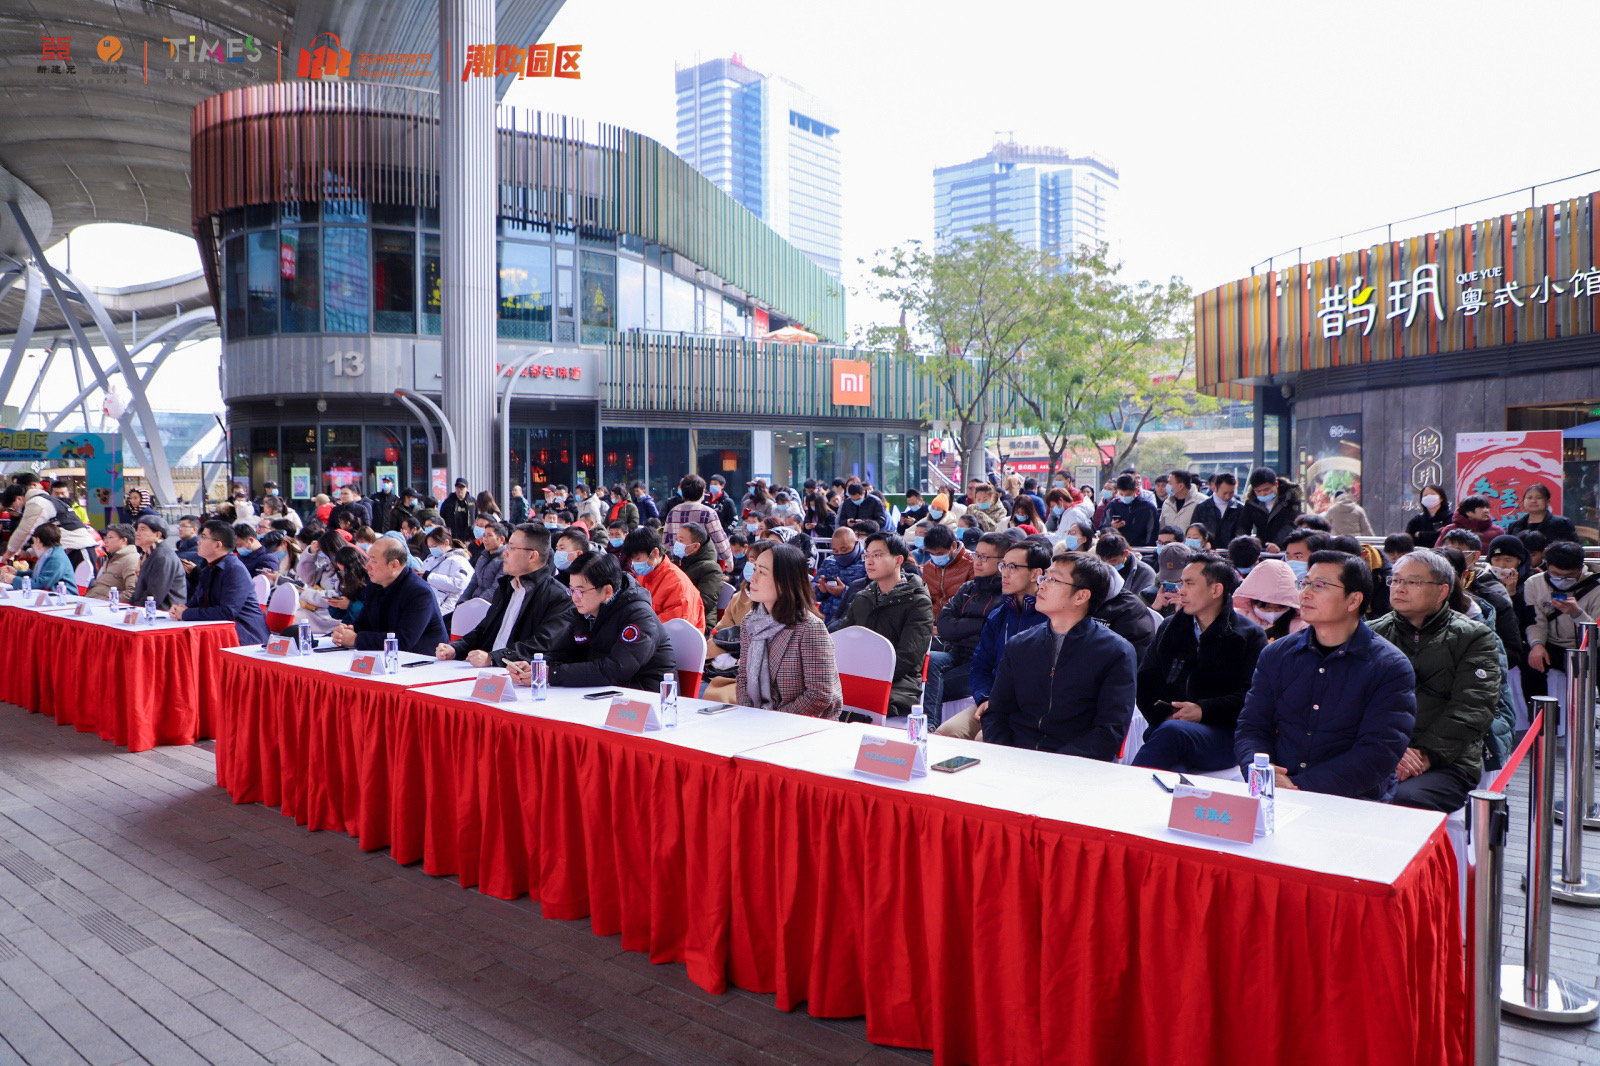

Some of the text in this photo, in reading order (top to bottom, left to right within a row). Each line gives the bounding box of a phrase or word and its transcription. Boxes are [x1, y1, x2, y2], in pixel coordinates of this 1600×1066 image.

[1455, 266, 1503, 285] QUE YUE
[1455, 266, 1600, 316] 粤式小馆
[1316, 263, 1444, 338] 鹊玥
[326, 351, 366, 377] 13
